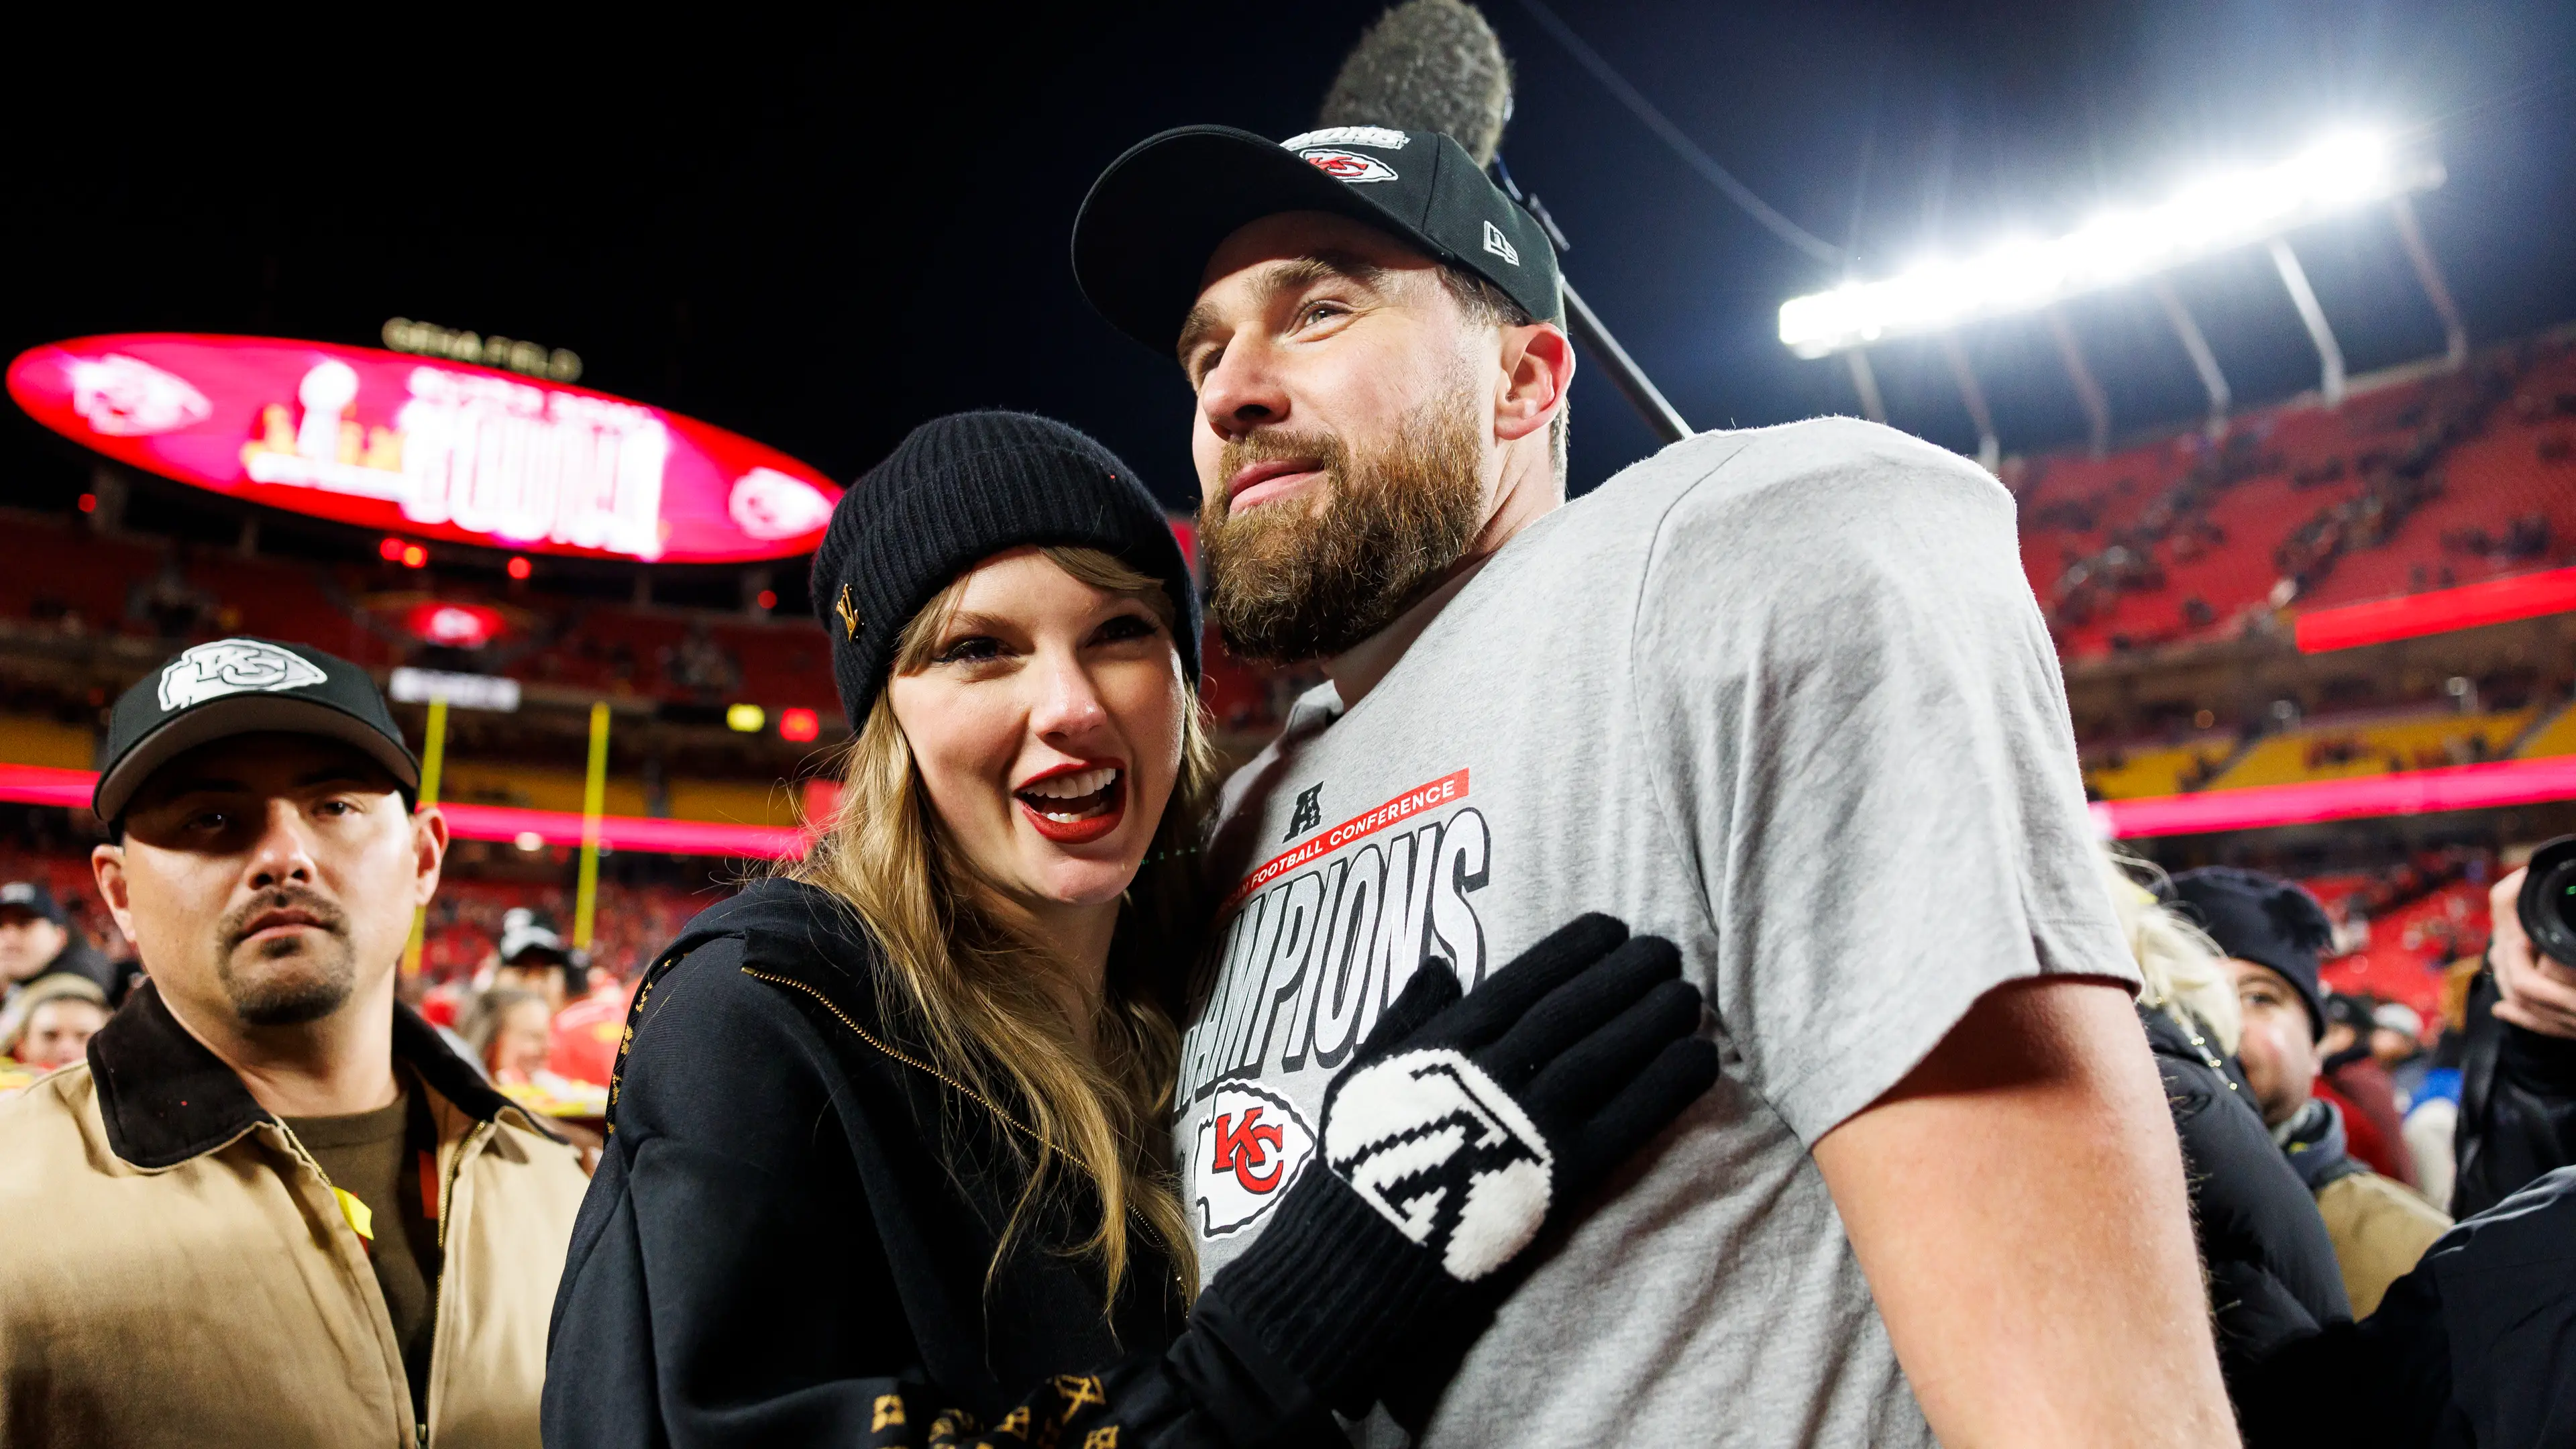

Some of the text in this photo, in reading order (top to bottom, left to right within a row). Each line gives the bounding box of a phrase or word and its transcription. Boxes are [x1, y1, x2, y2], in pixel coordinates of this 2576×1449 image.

[196, 647, 287, 686] KC
[1251, 779, 1455, 888] FOOTBALL CONFERENCE
[1212, 1106, 1284, 1195] KC
